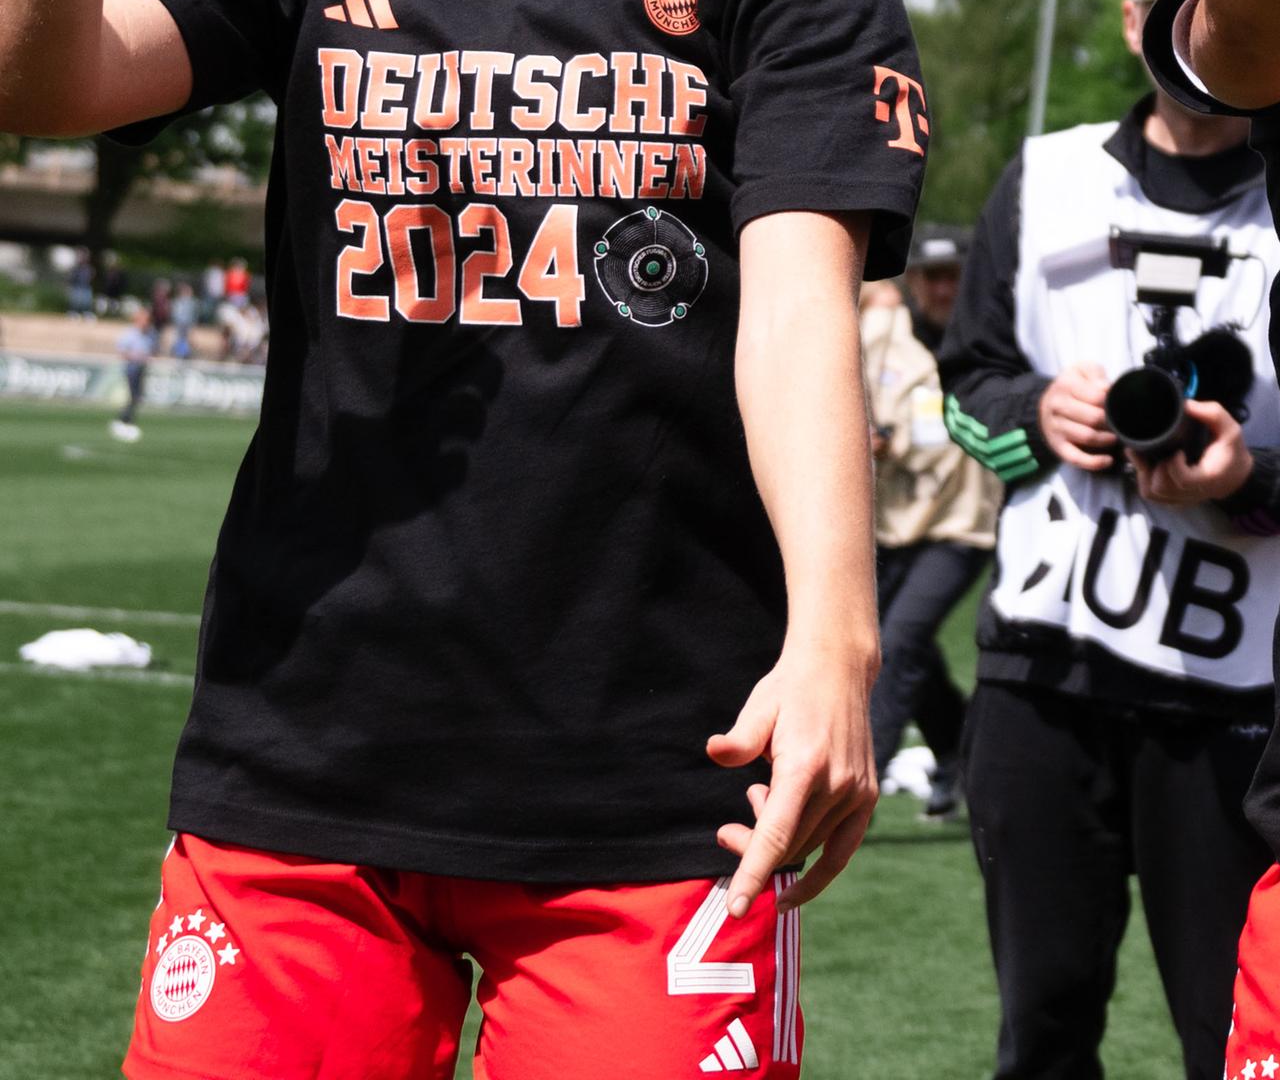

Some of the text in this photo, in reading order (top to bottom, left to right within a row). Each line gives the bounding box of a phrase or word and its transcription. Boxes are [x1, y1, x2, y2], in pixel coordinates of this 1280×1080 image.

[318, 48, 709, 137] DEUTSCHE
[324, 133, 707, 200] MEISTERINNEN
[335, 198, 586, 328] 2024
